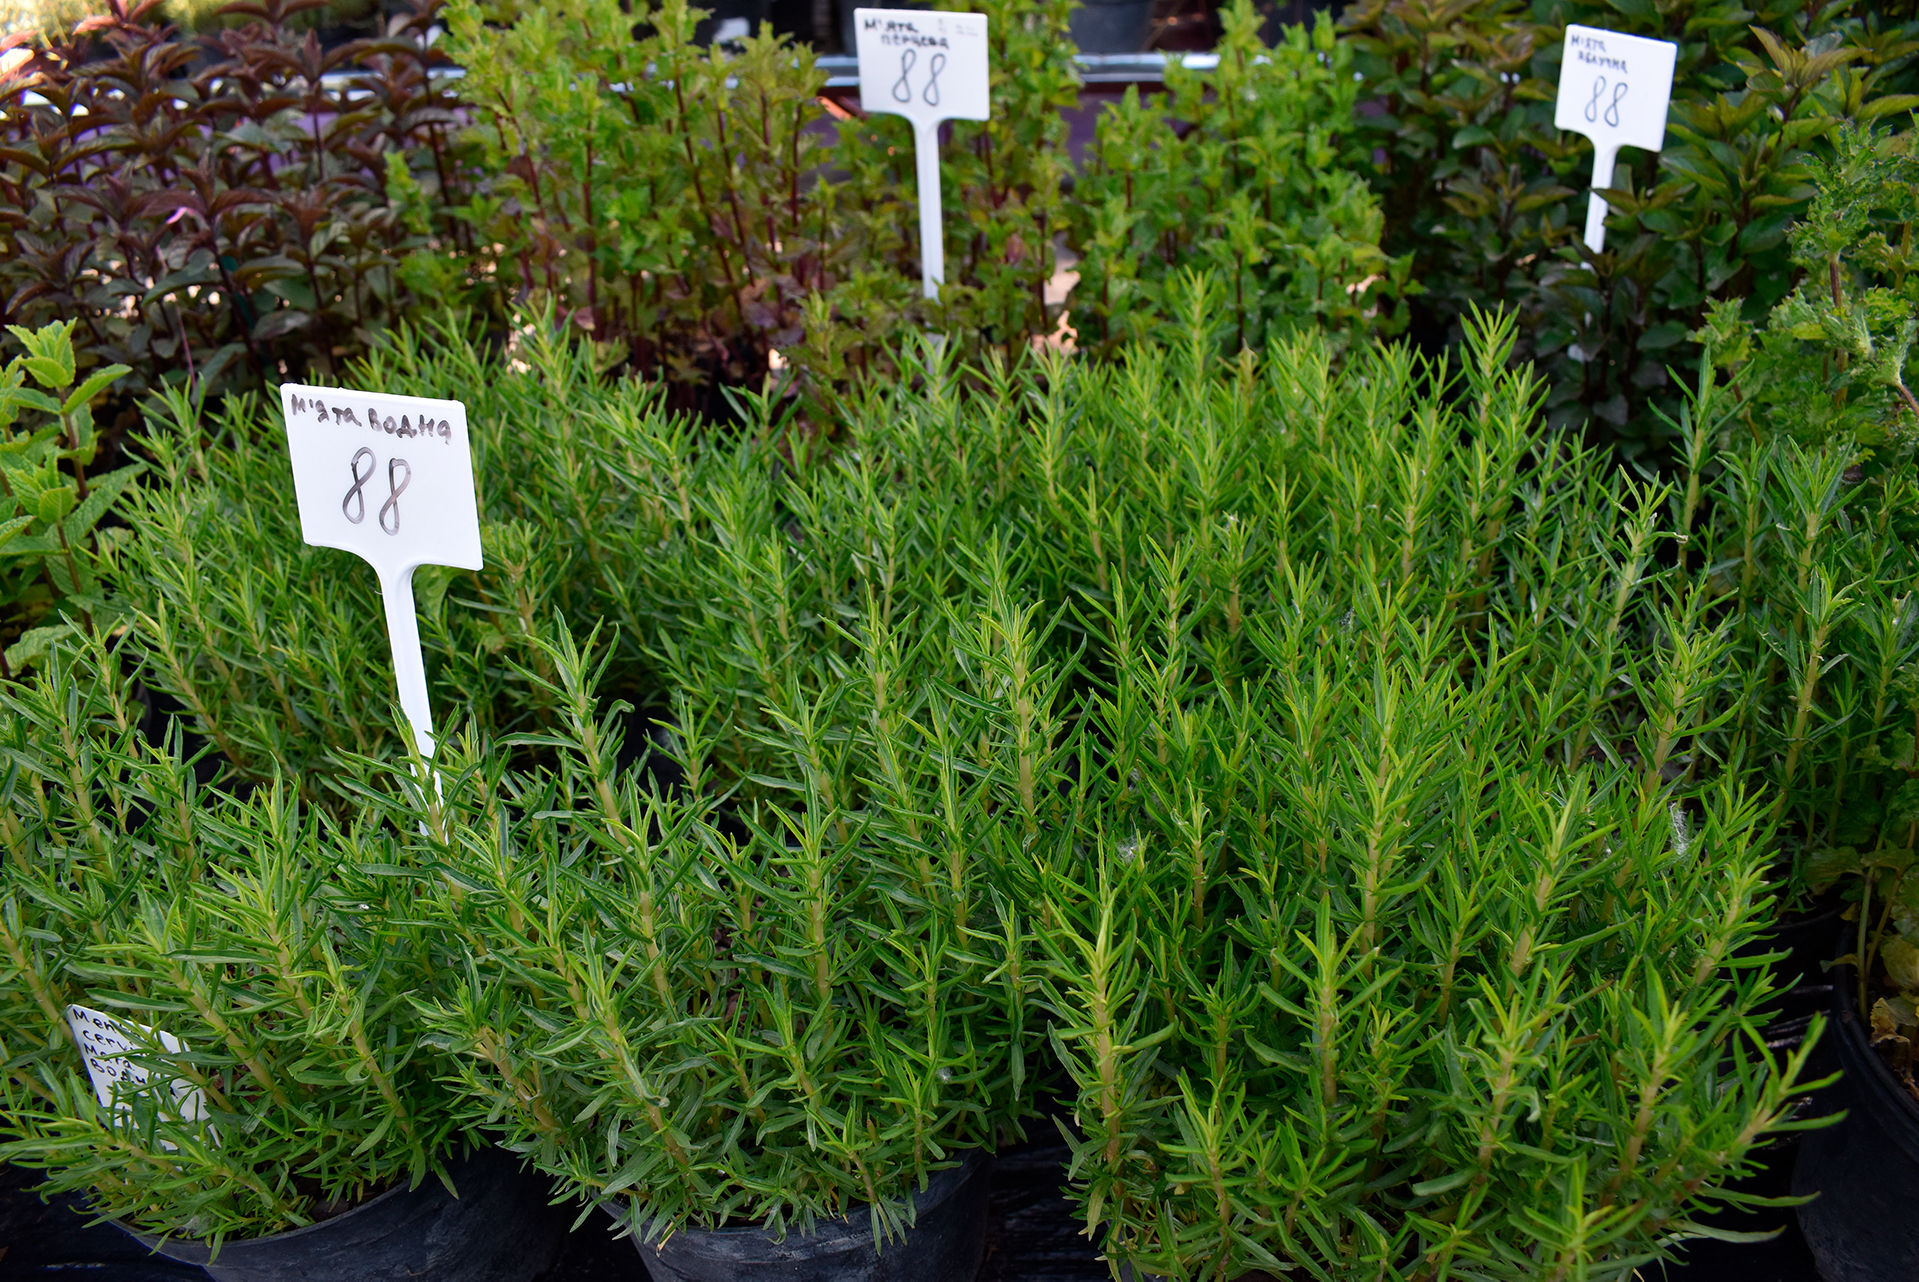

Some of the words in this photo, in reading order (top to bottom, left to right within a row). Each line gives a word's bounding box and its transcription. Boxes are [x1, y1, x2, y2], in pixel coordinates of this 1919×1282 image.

[892, 48, 946, 107] 88
[1584, 75, 1628, 127] 88
[291, 393, 362, 427] М'ята
[342, 446, 412, 536] 88
